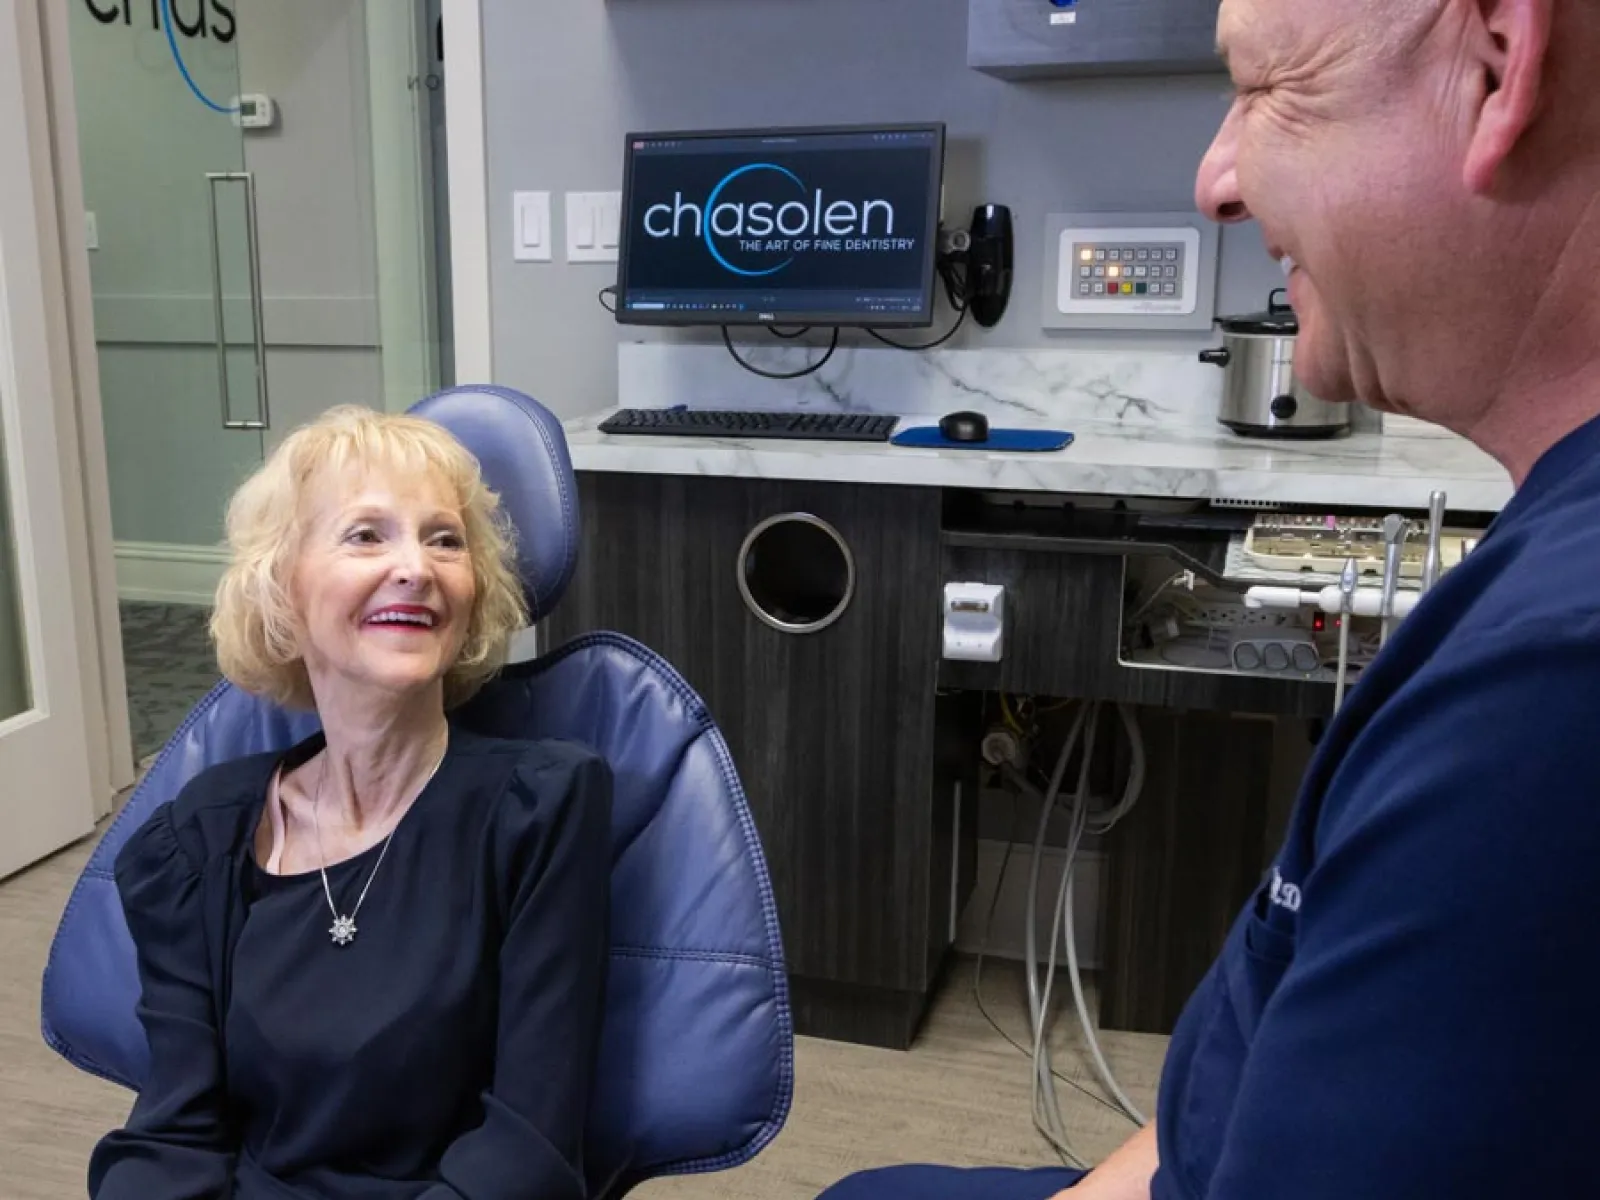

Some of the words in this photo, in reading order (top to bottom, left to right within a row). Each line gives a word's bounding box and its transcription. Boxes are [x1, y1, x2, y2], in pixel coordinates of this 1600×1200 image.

[643, 188, 895, 238] chasolen
[739, 239, 762, 251] THE
[765, 239, 790, 251] ART
[792, 239, 811, 251] OF
[814, 239, 842, 250] FINE
[845, 238, 915, 250] DENTISTRY
